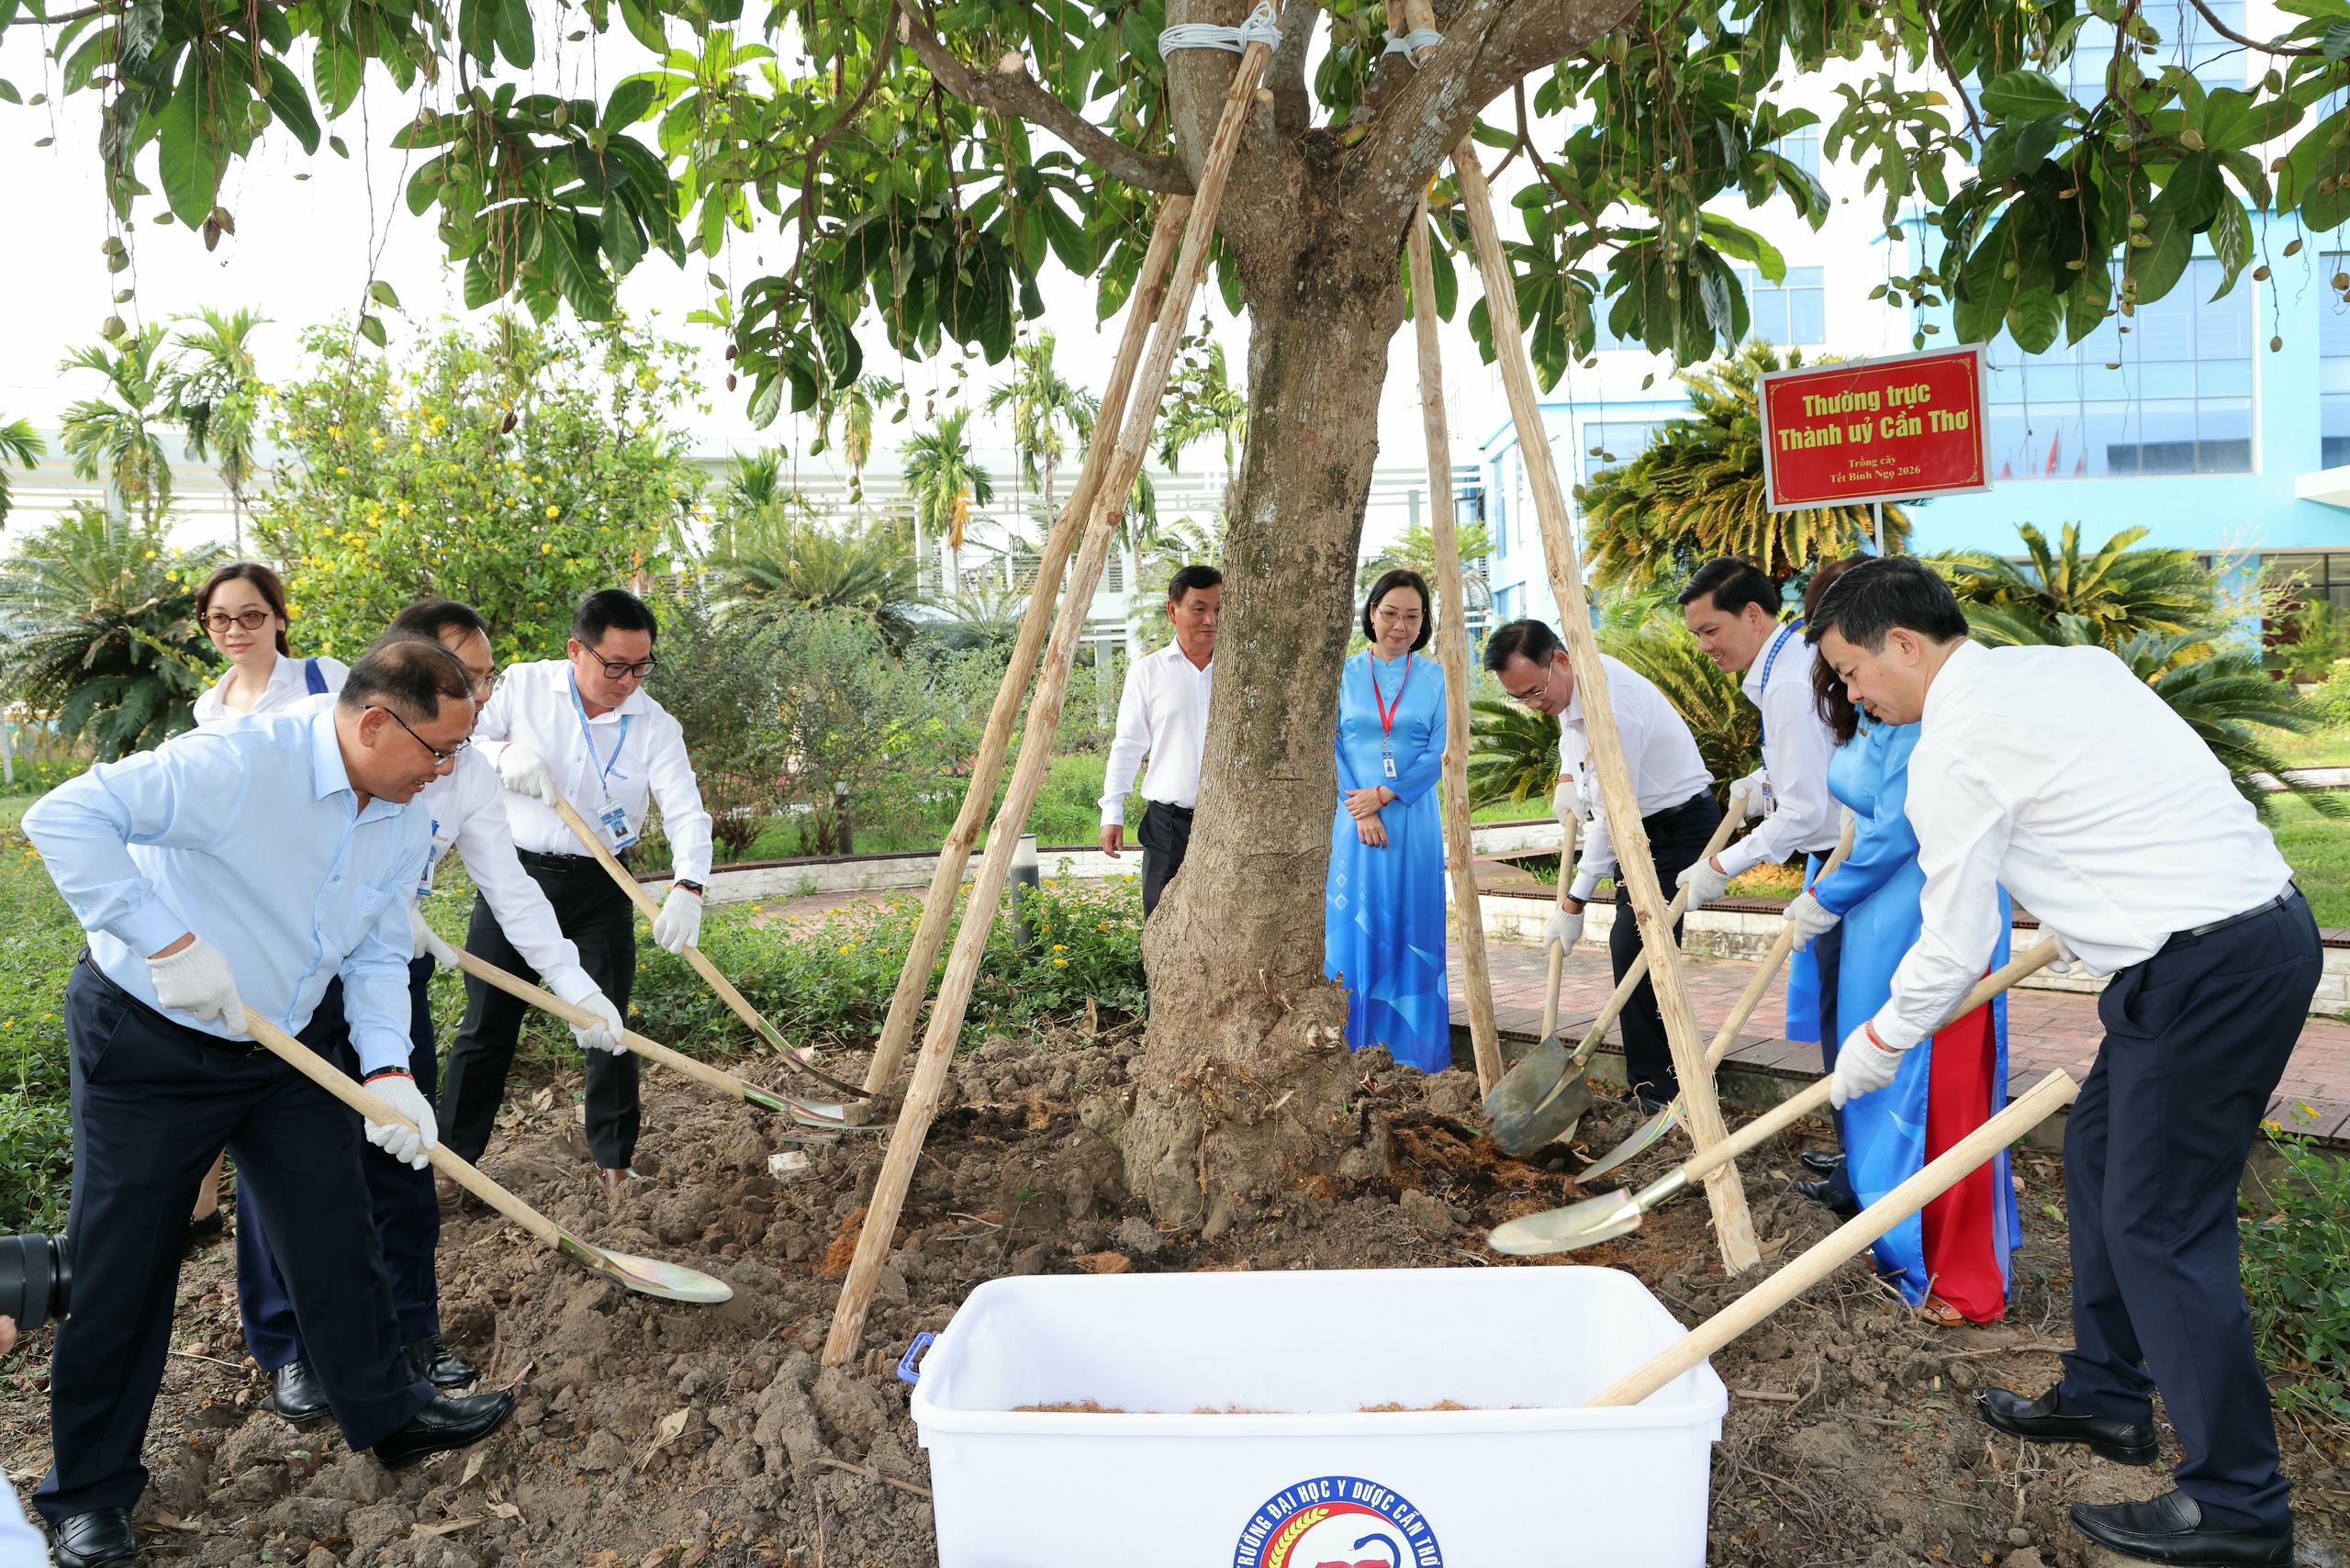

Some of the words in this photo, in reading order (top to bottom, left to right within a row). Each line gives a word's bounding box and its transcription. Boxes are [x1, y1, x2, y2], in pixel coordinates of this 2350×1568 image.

[1802, 389, 1881, 418] Thường
[1886, 383, 1931, 409] trực
[1778, 423, 1842, 451] Thành
[1848, 416, 1874, 444] uỷ
[1880, 409, 1922, 439] Cần
[1928, 409, 1969, 433] Thơ
[1830, 471, 1846, 483] Tết
[1849, 471, 1872, 481] Bính
[1874, 469, 1896, 479] Ngọ
[1897, 465, 1921, 476] 2026
[1848, 455, 1878, 468] Trồng
[1880, 455, 1897, 466] cây
[1266, 1491, 1298, 1520] ĐẠI
[1296, 1480, 1332, 1504] HỌC
[1337, 1479, 1347, 1497] Y
[1352, 1481, 1395, 1512] DƯỢC
[1392, 1503, 1426, 1538] CẦN
[1414, 1535, 1441, 1567] THƠ
